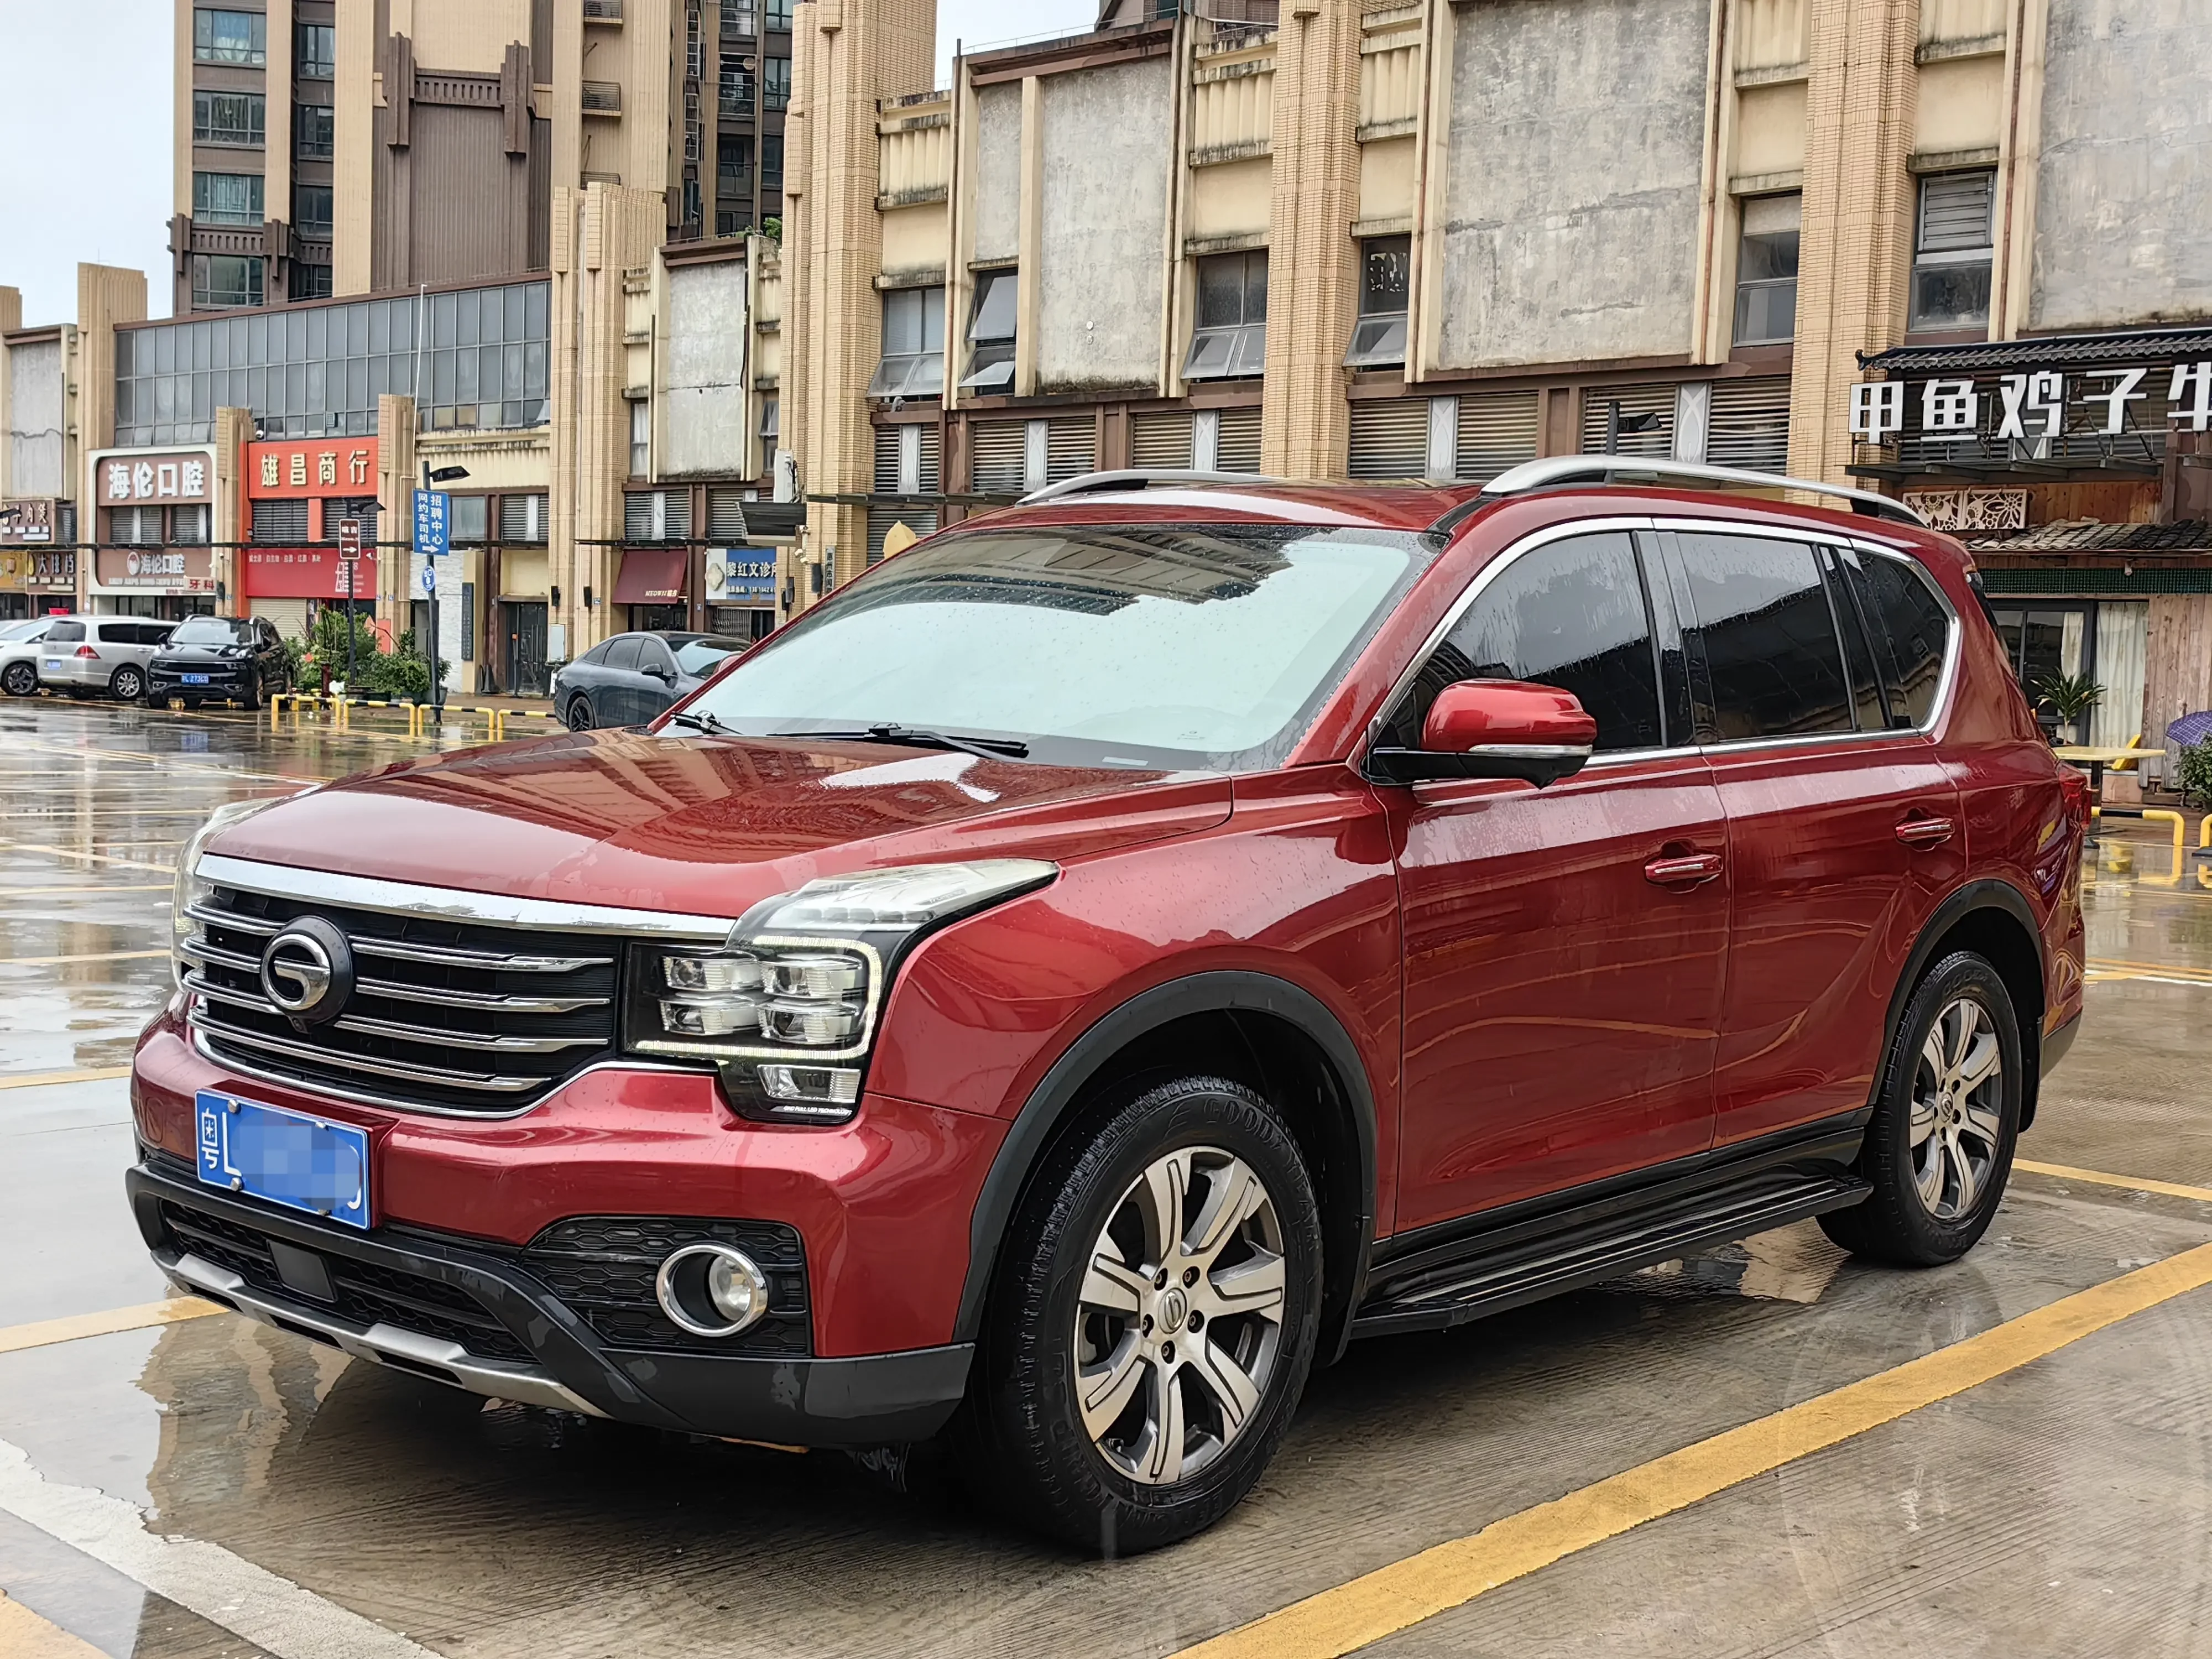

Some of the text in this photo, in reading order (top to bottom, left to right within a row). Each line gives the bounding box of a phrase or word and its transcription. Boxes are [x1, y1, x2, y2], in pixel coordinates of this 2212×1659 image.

[108, 460, 205, 499] 海伦口腔
[261, 450, 368, 487] 雄昌商行
[418, 493, 430, 544] 网约车司机
[431, 494, 444, 545] 招聘中心
[141, 554, 185, 574] 海伦口腔
[189, 579, 215, 590] 牙科
